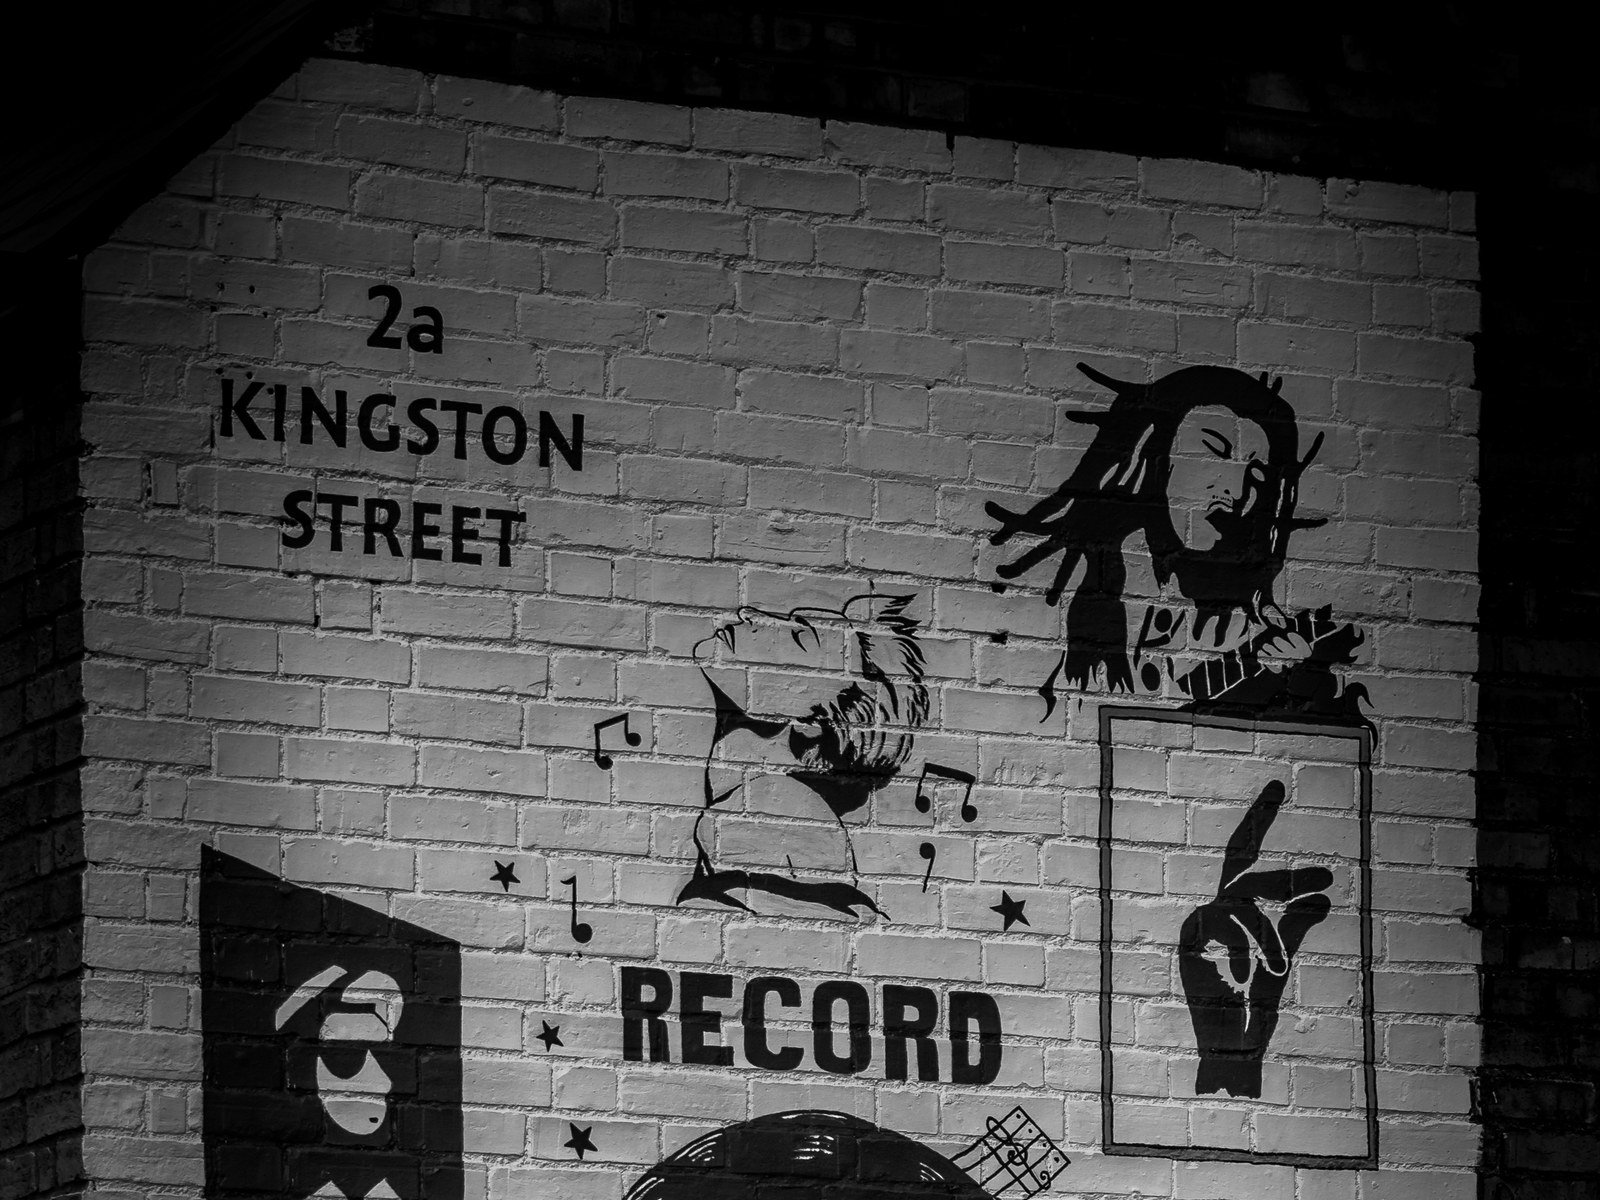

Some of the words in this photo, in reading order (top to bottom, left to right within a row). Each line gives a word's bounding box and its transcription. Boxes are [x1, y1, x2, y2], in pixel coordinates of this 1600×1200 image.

[367, 285, 443, 354] 2a
[219, 378, 585, 471] KINGSTON
[281, 489, 527, 567] STREET
[621, 966, 1002, 1085] RECORD
